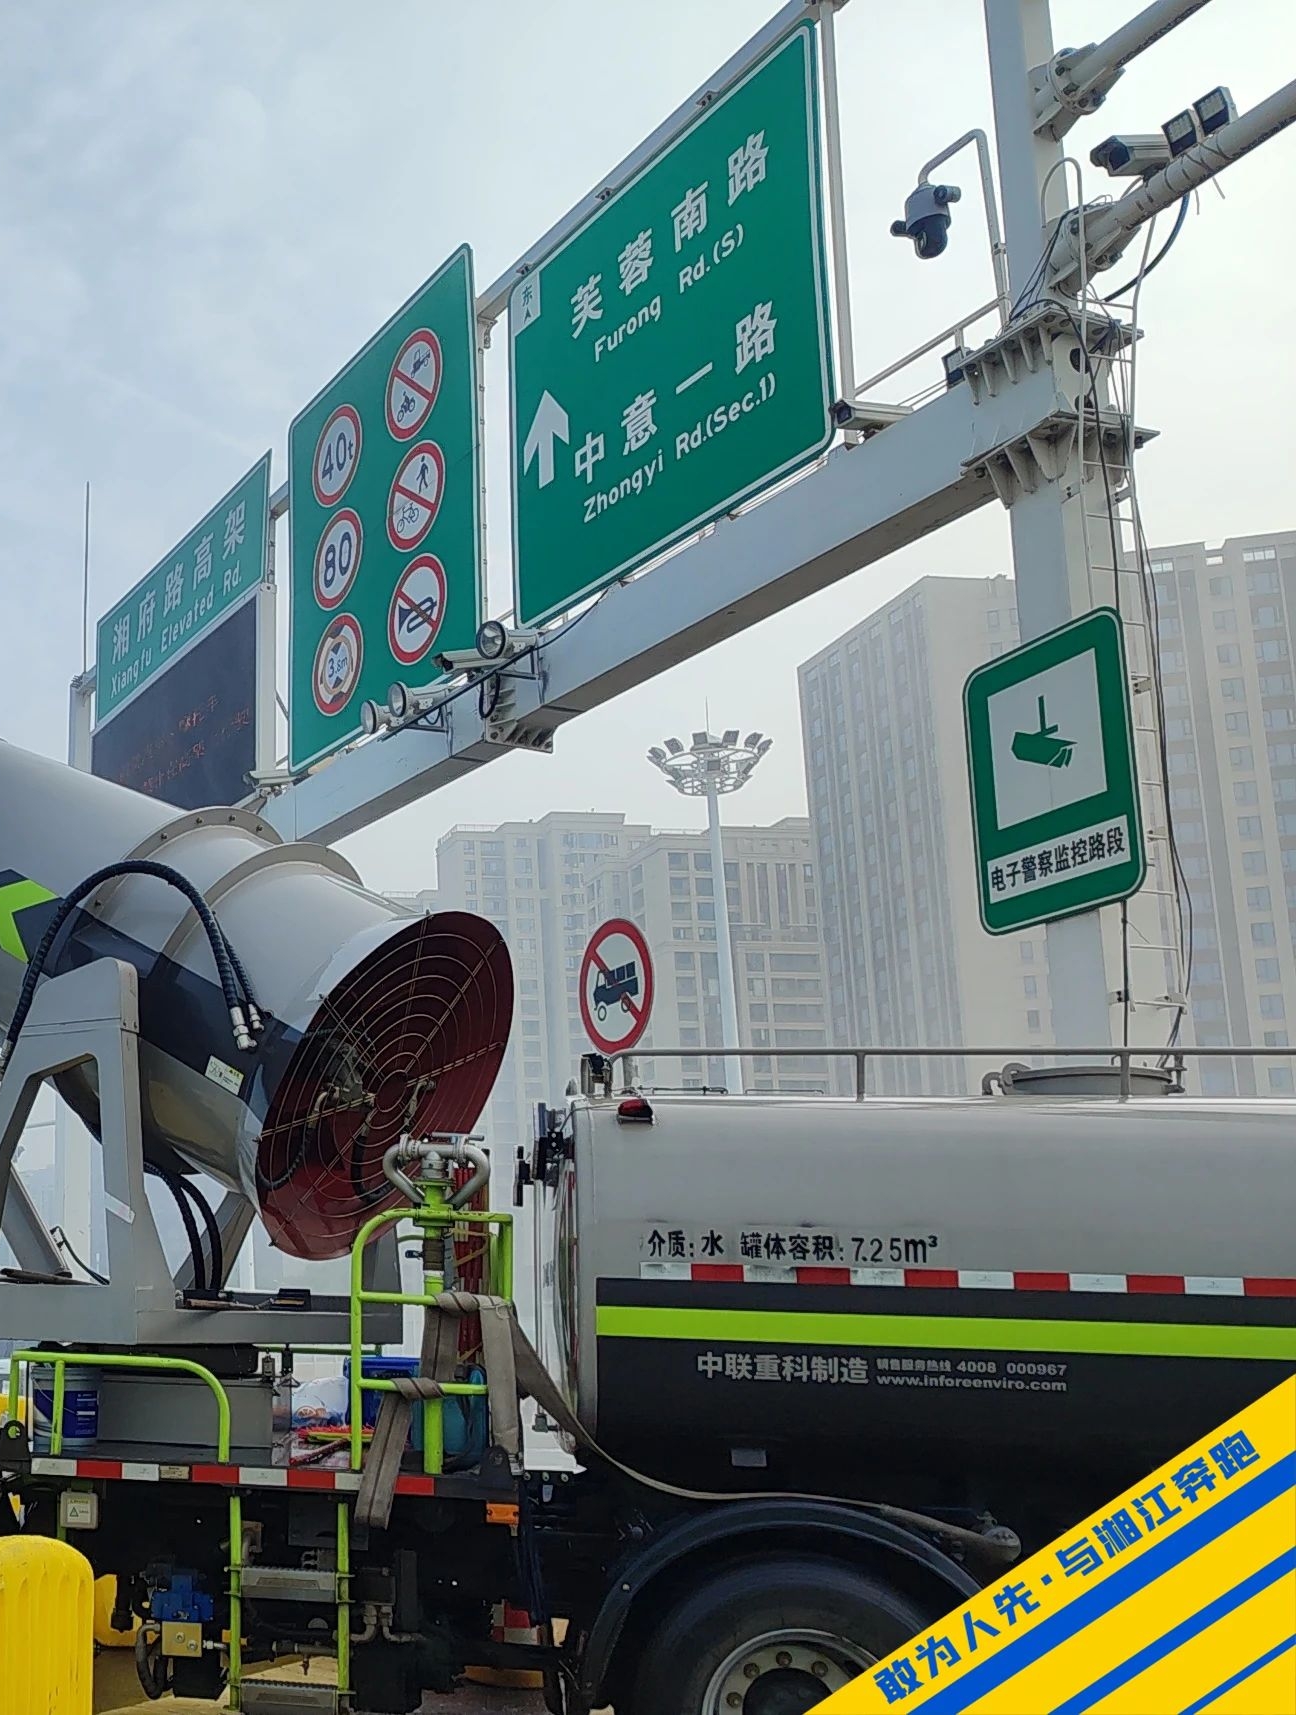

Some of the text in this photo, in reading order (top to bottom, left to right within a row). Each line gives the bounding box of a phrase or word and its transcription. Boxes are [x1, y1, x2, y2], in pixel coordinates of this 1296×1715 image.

[570, 129, 769, 340] 芙蓉南路
[520, 283, 533, 307] 东
[594, 295, 662, 363] Furong
[574, 300, 778, 485] 中意一路
[321, 432, 354, 484] 40t
[583, 458, 664, 523] Zhongyi
[112, 500, 246, 665] 湘府路高架
[324, 531, 353, 589] 80
[110, 560, 242, 699] Xiangfu Elevated Rd.
[991, 826, 1126, 892] 电子警察监控路段
[697, 1351, 869, 1384] 中联重科制造
[876, 1374, 1067, 1391] www.inforeenviro.com
[956, 1360, 997, 1373] 4008
[1006, 1361, 1067, 1376] 000967
